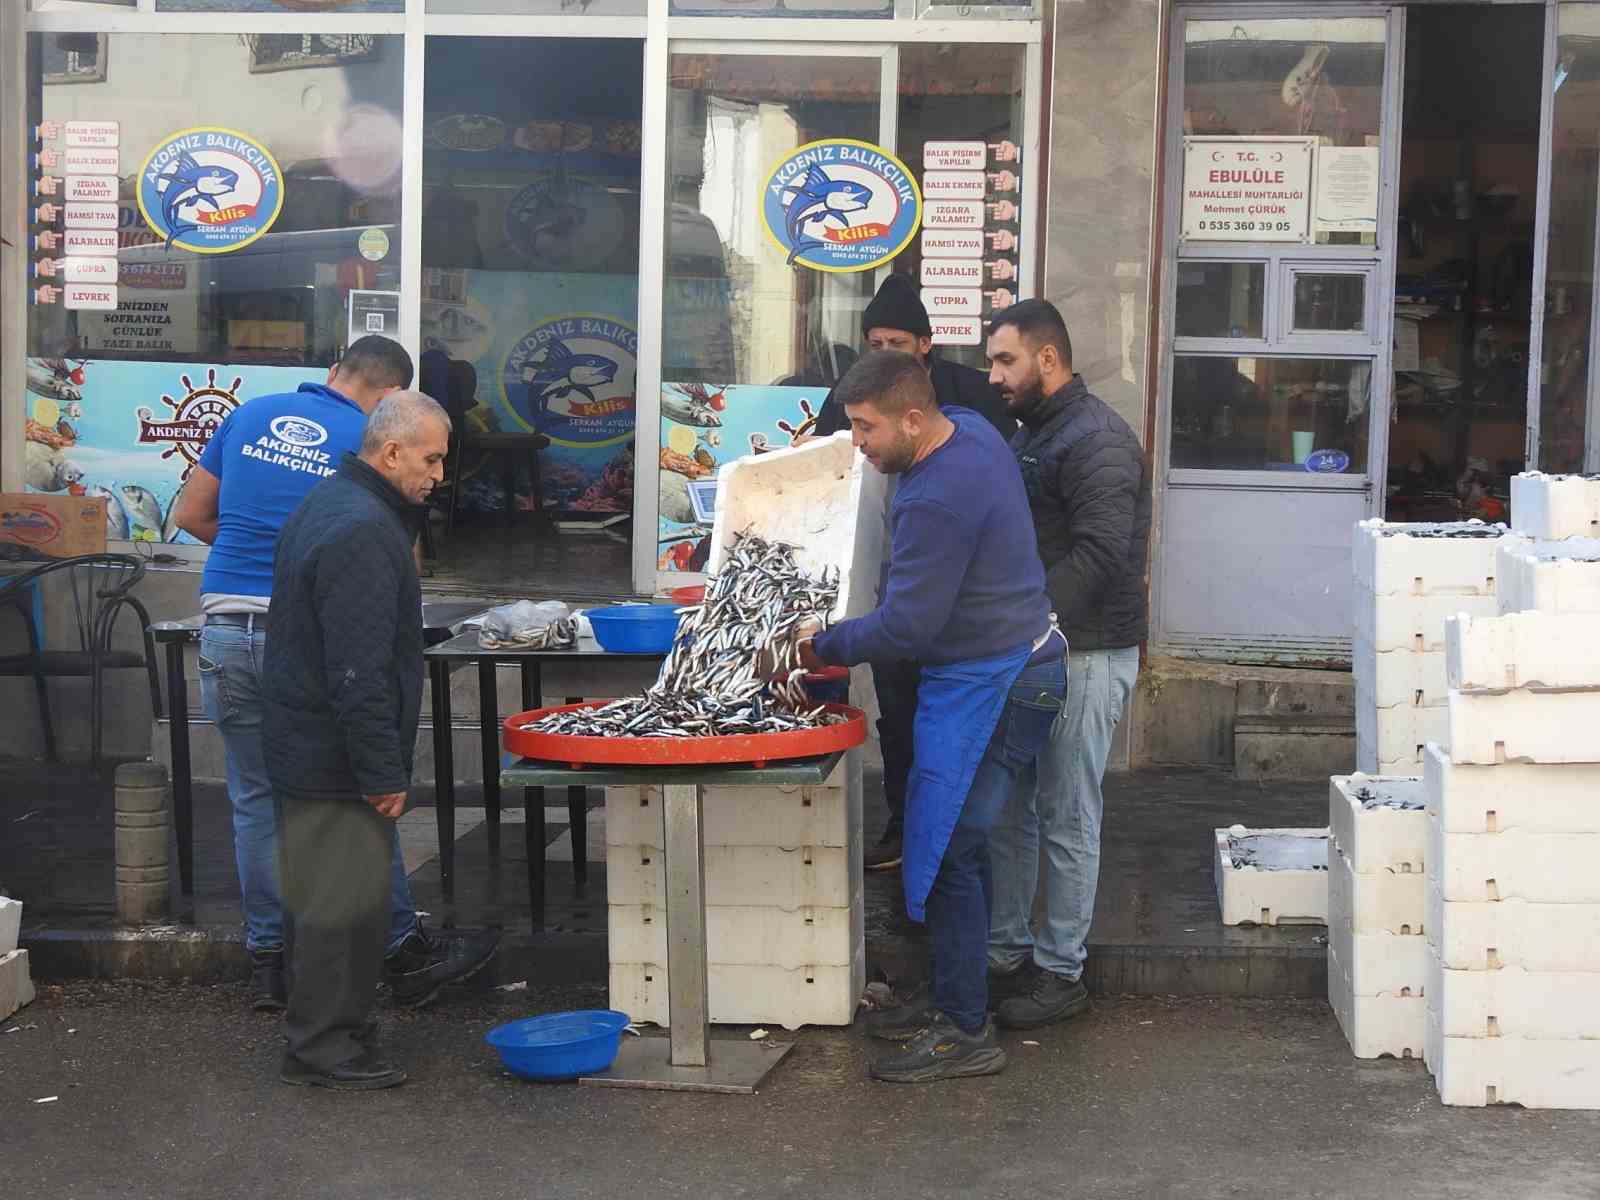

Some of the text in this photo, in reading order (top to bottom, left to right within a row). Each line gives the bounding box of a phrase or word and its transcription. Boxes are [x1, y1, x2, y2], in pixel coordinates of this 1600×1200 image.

[146, 134, 275, 185] AKDENİZ BALIKÇILIK
[1237, 152, 1259, 162] T.C.
[771, 145, 914, 205] AKDENİZ BALIKÇILIK
[1209, 169, 1285, 183] EBULÜLE
[72, 189, 111, 197] PALAMUT
[1189, 190, 1303, 200] MAHALLESİ MUHTARLIĞI
[209, 208, 247, 222] Kilis
[1204, 204, 1286, 216] Mehmet ÇÜRÜK
[67, 211, 116, 220] HAMSİ TAVA
[931, 216, 976, 224] PALAMUT
[1199, 221, 1291, 231] 0 535 360 39 05
[838, 226, 880, 240] Kilis
[68, 237, 115, 246] ALABALIK
[925, 240, 956, 248] HAMSİ
[823, 243, 889, 254] SERKAN AYGÜN
[77, 264, 107, 273] ÇUPRA
[925, 267, 979, 276] ALABALIK
[72, 292, 110, 301] LEVREK
[934, 296, 969, 306] ÇUPRA
[116, 301, 169, 312] ENİZDEN
[103, 314, 172, 324] SOFRANIZA
[103, 339, 173, 350] TAZE BALIK
[510, 319, 637, 371] AKDENİZ BALIKÇ
[147, 426, 202, 439] AKDENİZ
[256, 436, 331, 464] AKDENİZ
[241, 444, 337, 478] BALIKÇILIK
[1319, 455, 1334, 465] 24
